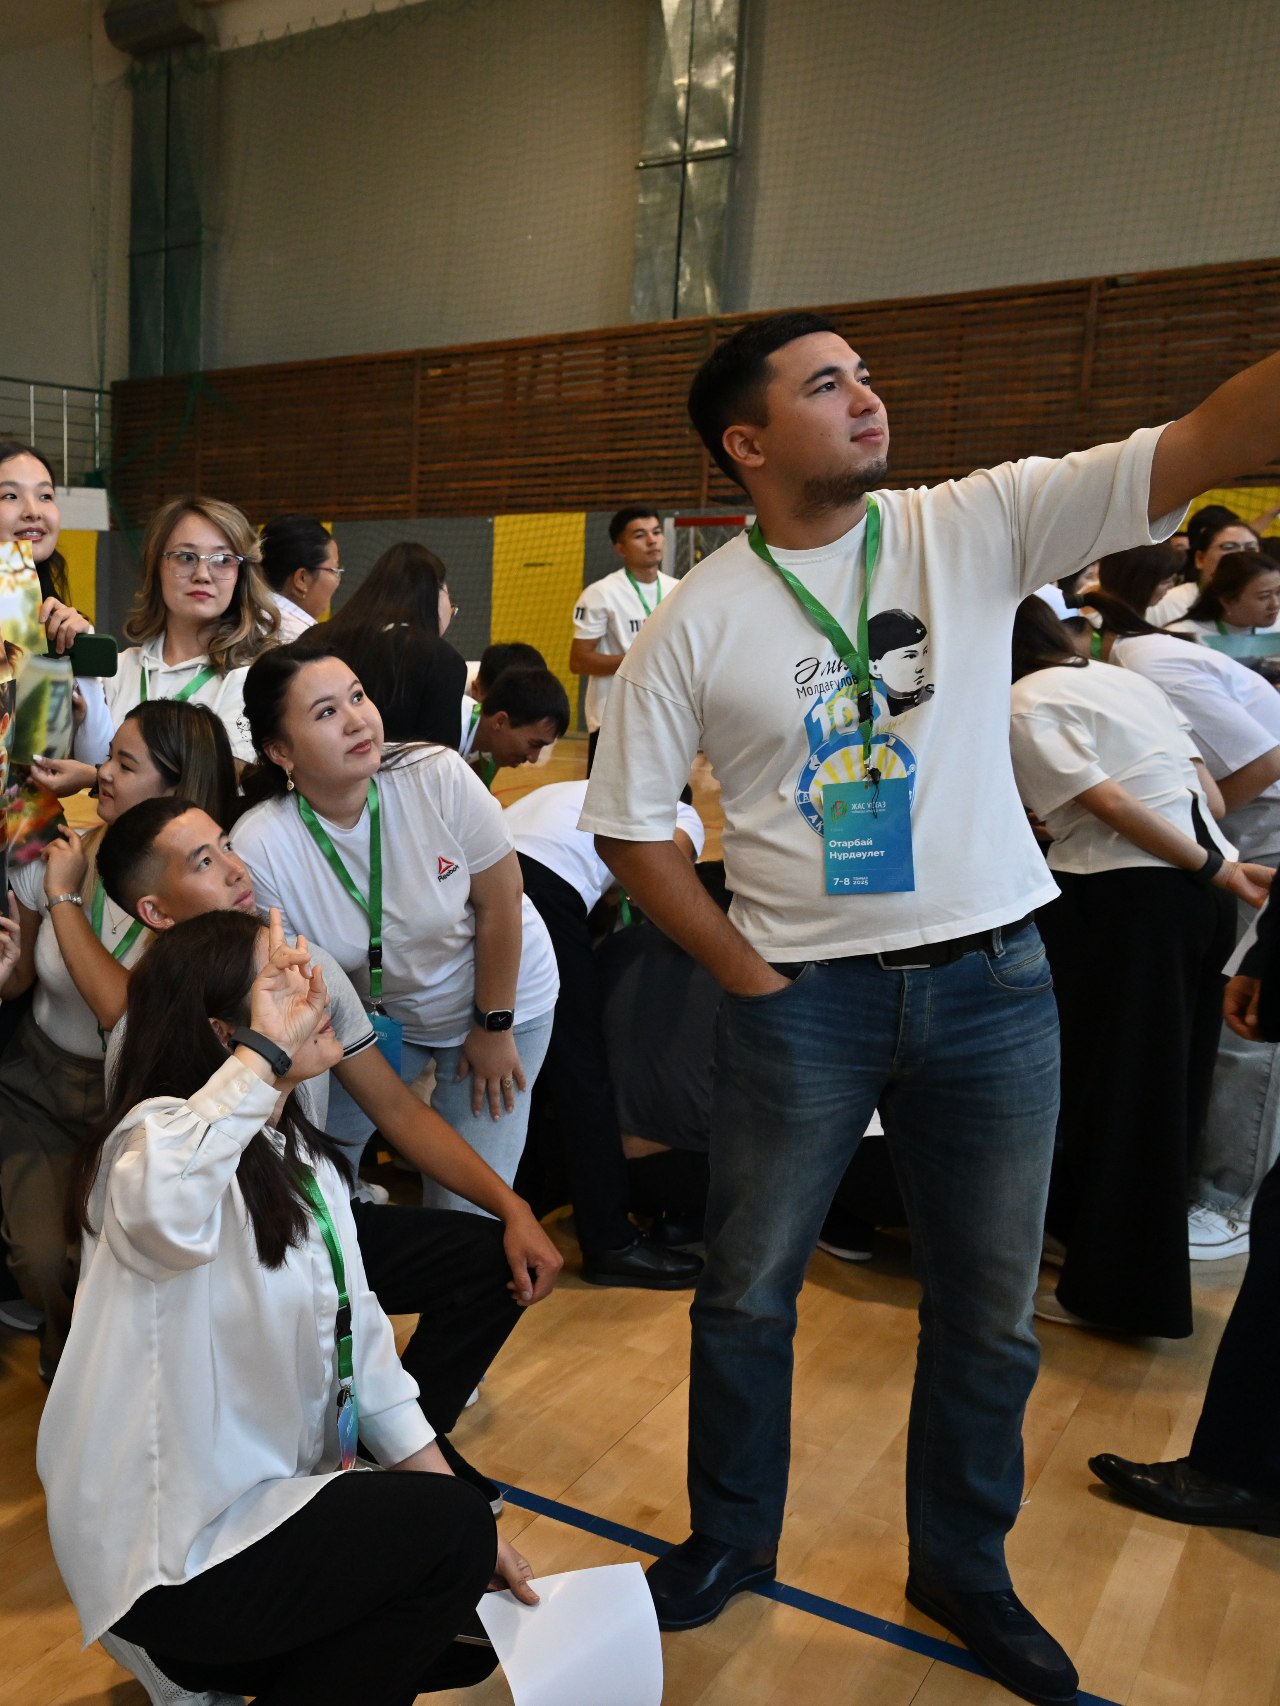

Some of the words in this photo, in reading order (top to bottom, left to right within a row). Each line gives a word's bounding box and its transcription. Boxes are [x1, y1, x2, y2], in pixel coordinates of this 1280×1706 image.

[575, 607, 584, 619] 11
[630, 620, 639, 632] 11
[829, 838, 873, 849] Отарбай
[438, 865, 459, 882] Reebok
[833, 877, 850, 886] 7-8
